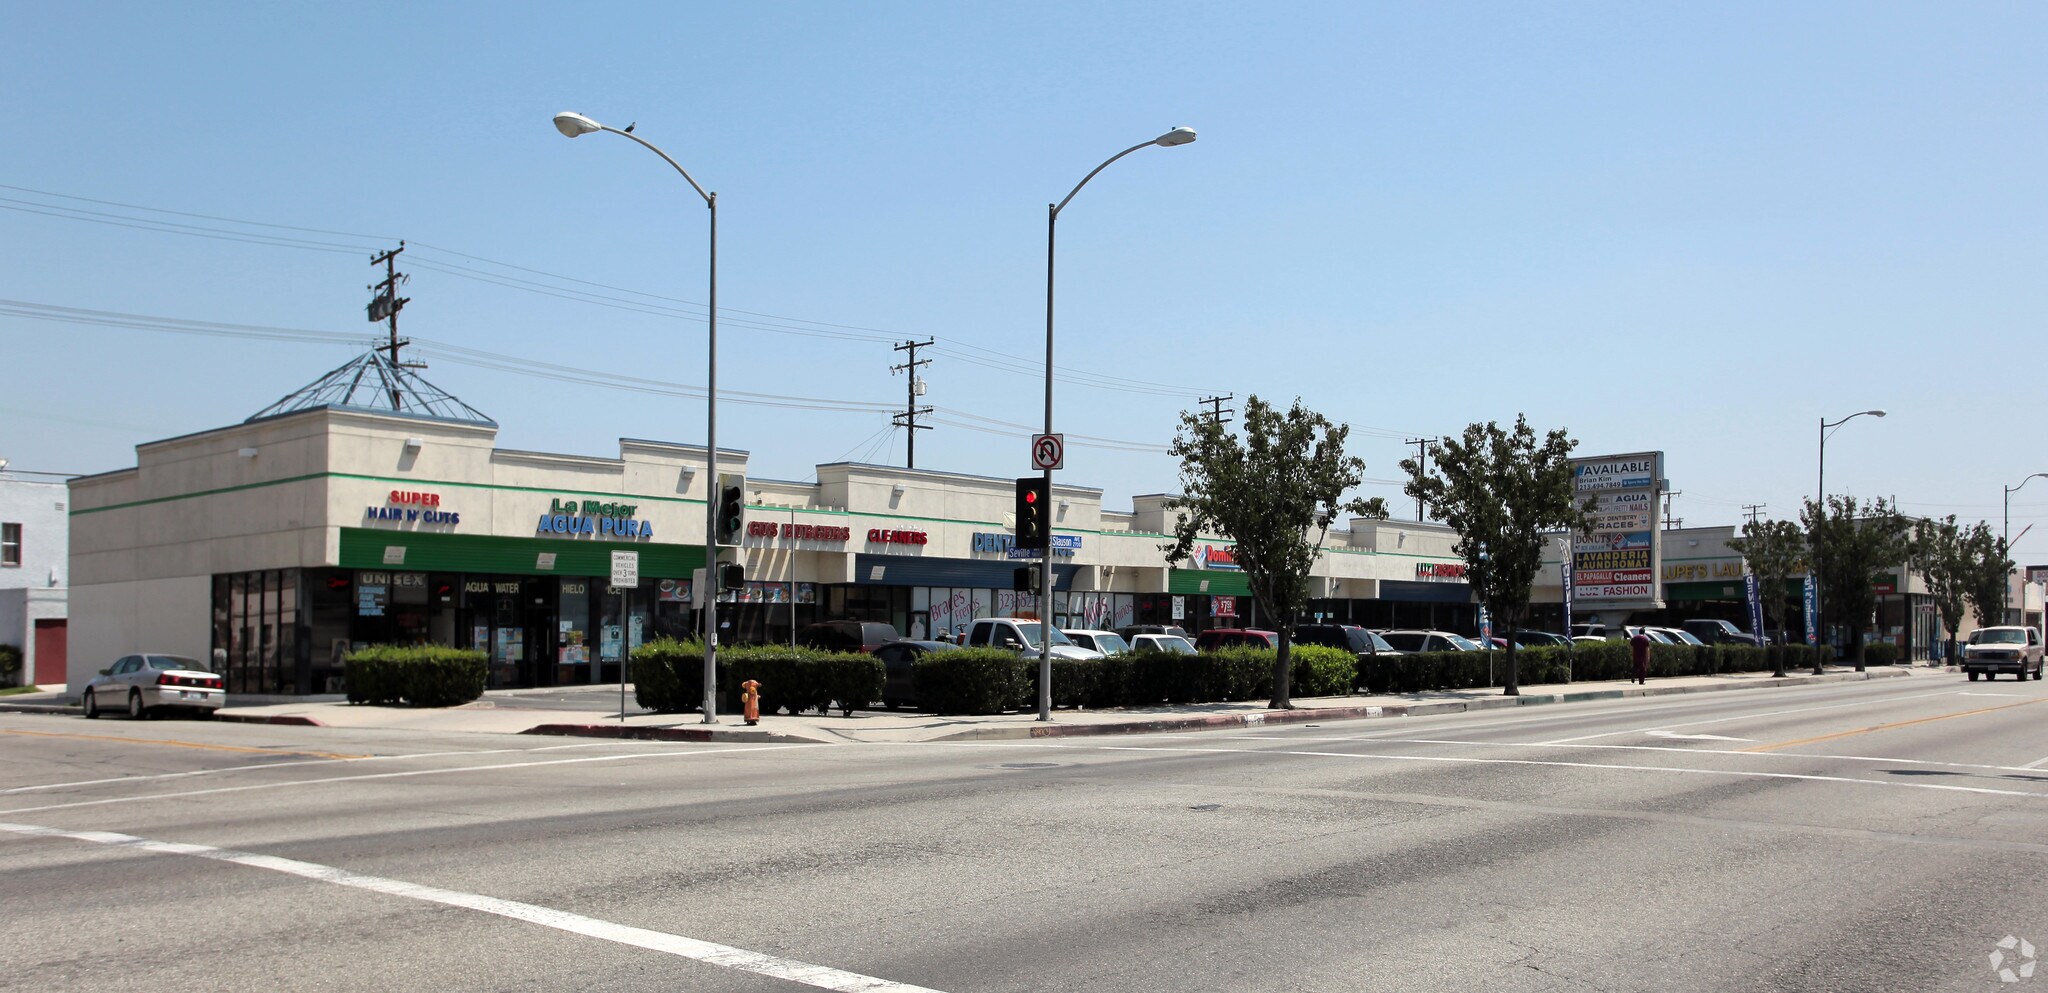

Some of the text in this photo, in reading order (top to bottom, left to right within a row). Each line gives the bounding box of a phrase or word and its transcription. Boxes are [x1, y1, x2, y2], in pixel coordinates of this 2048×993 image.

[1584, 461, 1650, 476] AVAILABLE
[1579, 476, 1597, 484] Brian
[1579, 482, 1621, 491] 213.494.7849
[389, 490, 440, 507] SUPER
[1615, 494, 1647, 503] AGUA
[553, 498, 638, 518] La Mejor
[1629, 503, 1649, 512] NAILS
[367, 506, 402, 521] HAIR
[424, 510, 460, 525] CUTS
[1607, 514, 1638, 522] DENTISTRY
[538, 514, 653, 538] AGUA PURA
[748, 521, 850, 542] GUS BURGERS
[868, 528, 928, 545] CLEANERS
[1052, 536, 1072, 547] Slauson
[1576, 534, 1611, 544] DONUTS
[973, 532, 1016, 553] DENT
[1009, 548, 1031, 558] Seville
[1576, 550, 1649, 561] LAVANDERIA
[1576, 559, 1649, 570] LAUNDROMAT
[623, 569, 628, 577] 3
[1576, 573, 1583, 581] EL
[1614, 572, 1651, 582] Cleaners
[1660, 564, 1707, 580] LUPE'S
[362, 574, 425, 586] UNISEX
[465, 582, 519, 593] AGUA WATER
[562, 584, 585, 594] HIELO
[607, 585, 621, 595] ICE
[1603, 586, 1648, 596] FASHION
